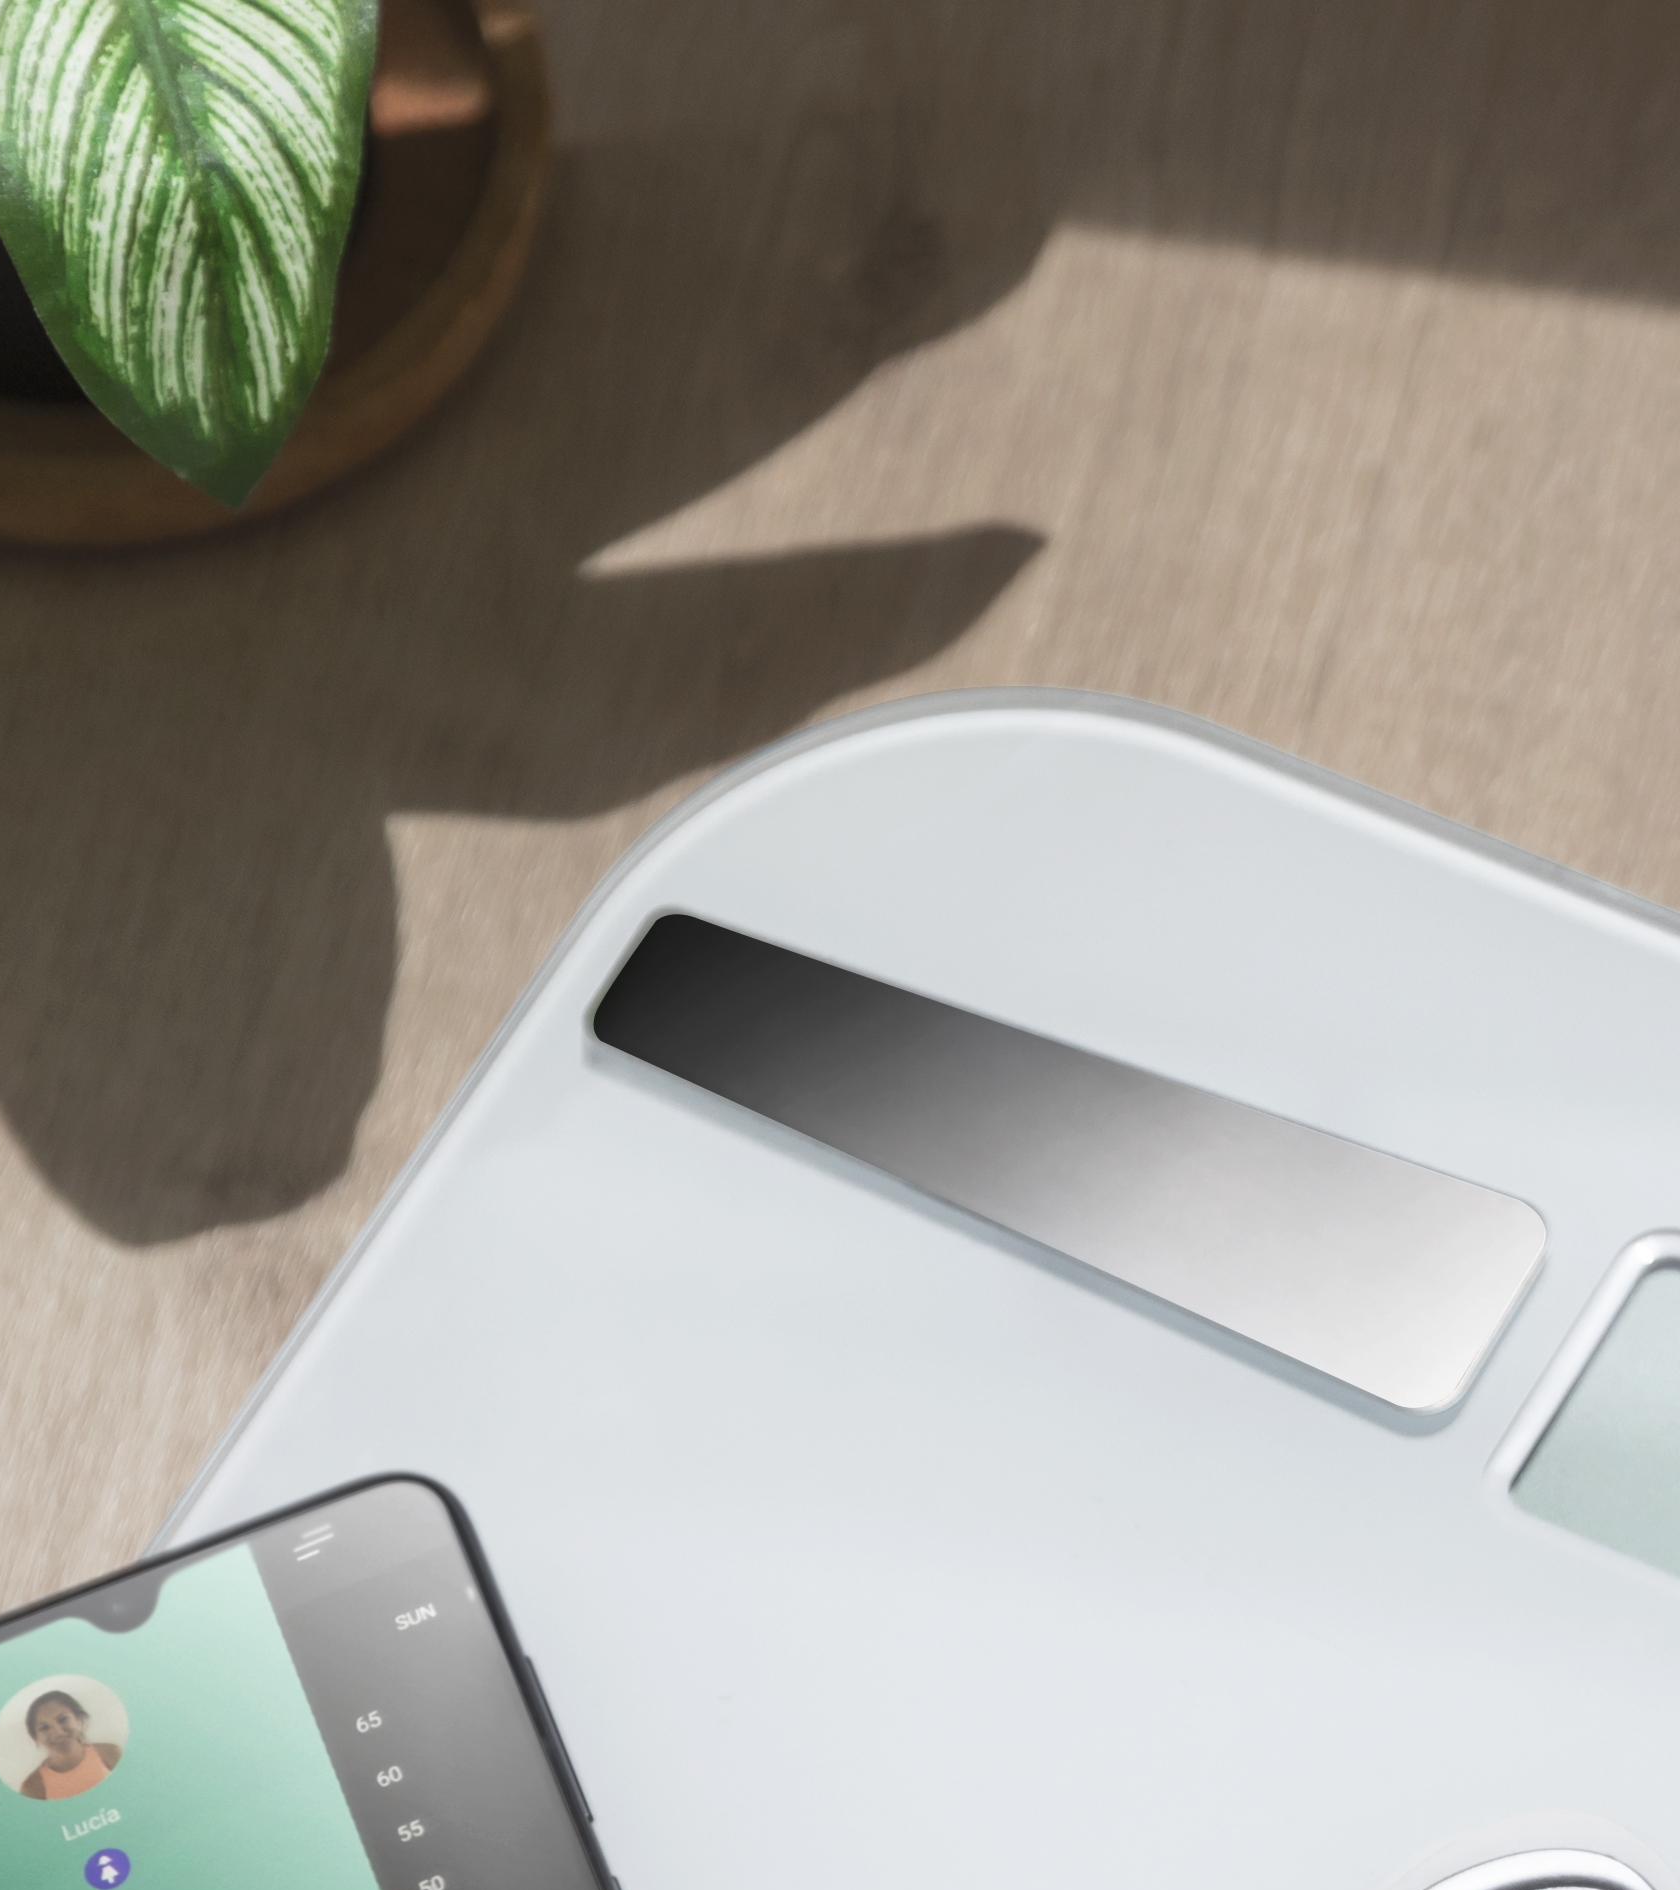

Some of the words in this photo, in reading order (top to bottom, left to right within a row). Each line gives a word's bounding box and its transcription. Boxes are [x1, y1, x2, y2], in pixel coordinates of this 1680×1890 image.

[394, 1603, 438, 1631] SUN
[355, 1711, 383, 1734] 65
[376, 1766, 404, 1788] 60
[61, 1804, 122, 1842] Lucía
[397, 1820, 426, 1843] 55
